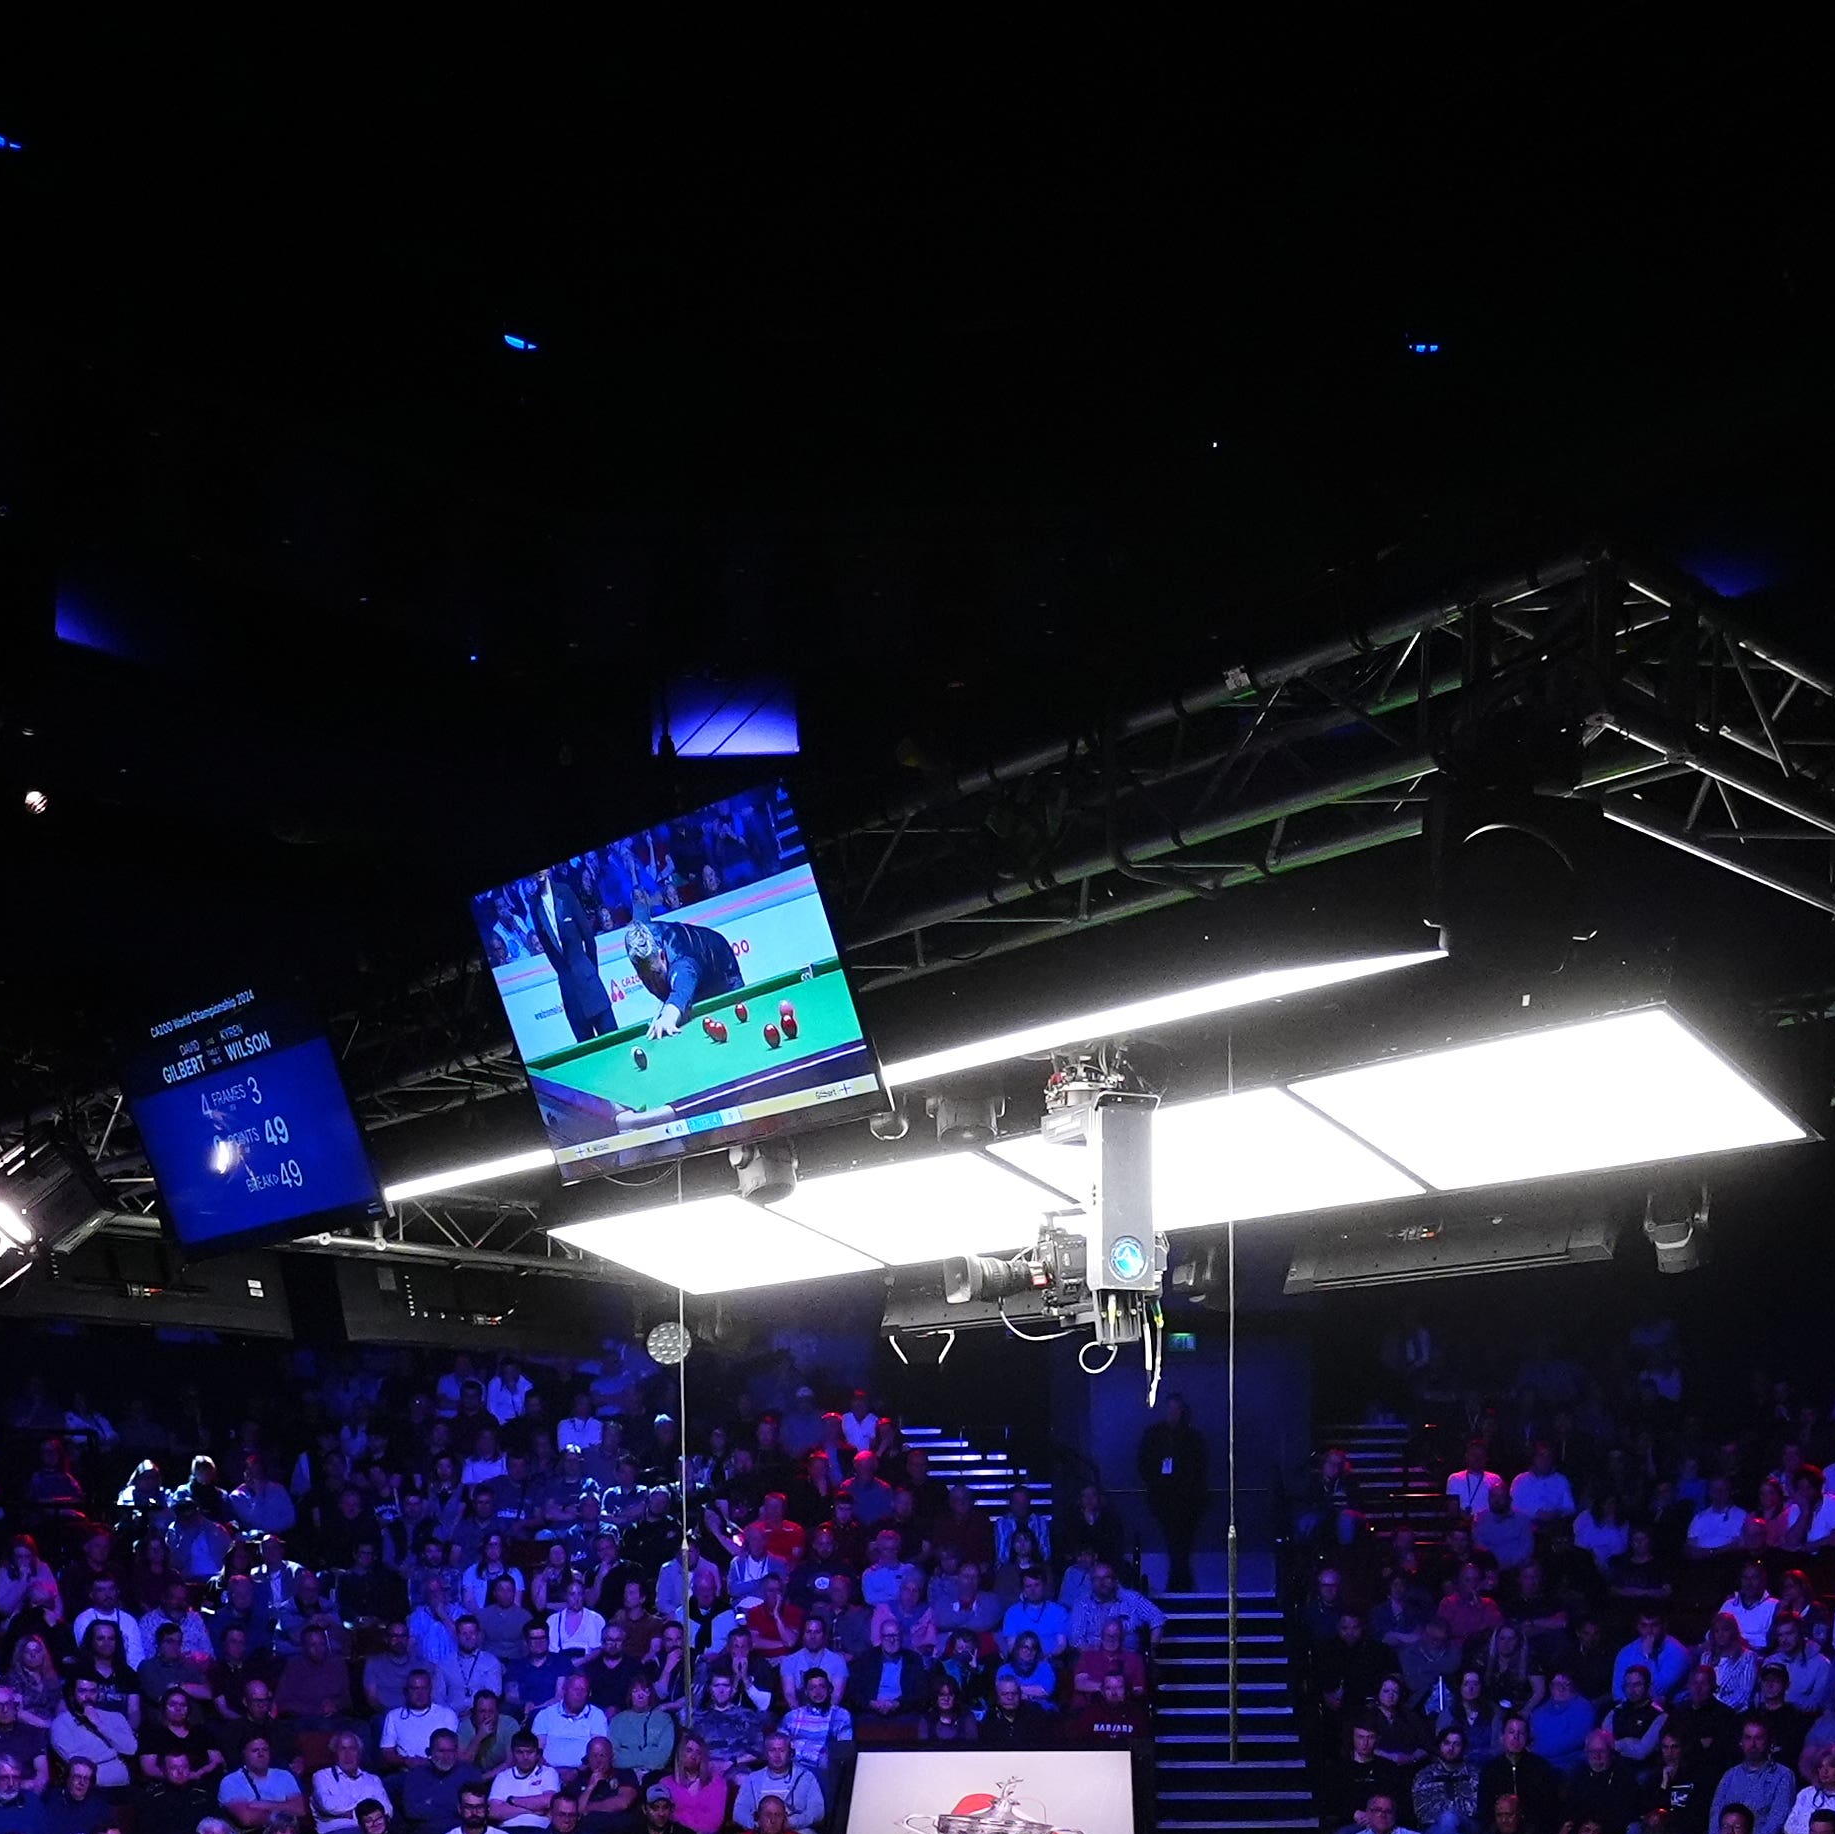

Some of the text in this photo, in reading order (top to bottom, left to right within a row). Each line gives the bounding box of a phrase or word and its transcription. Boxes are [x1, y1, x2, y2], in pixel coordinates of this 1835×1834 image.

[150, 989, 255, 1038] CAZOO World Championship 2024
[224, 1030, 272, 1062] WILSON
[162, 1054, 206, 1084] GILBERT
[201, 1076, 262, 1119] 4 FRAMES 3
[265, 1115, 290, 1146] 49
[279, 1159, 303, 1189] 49
